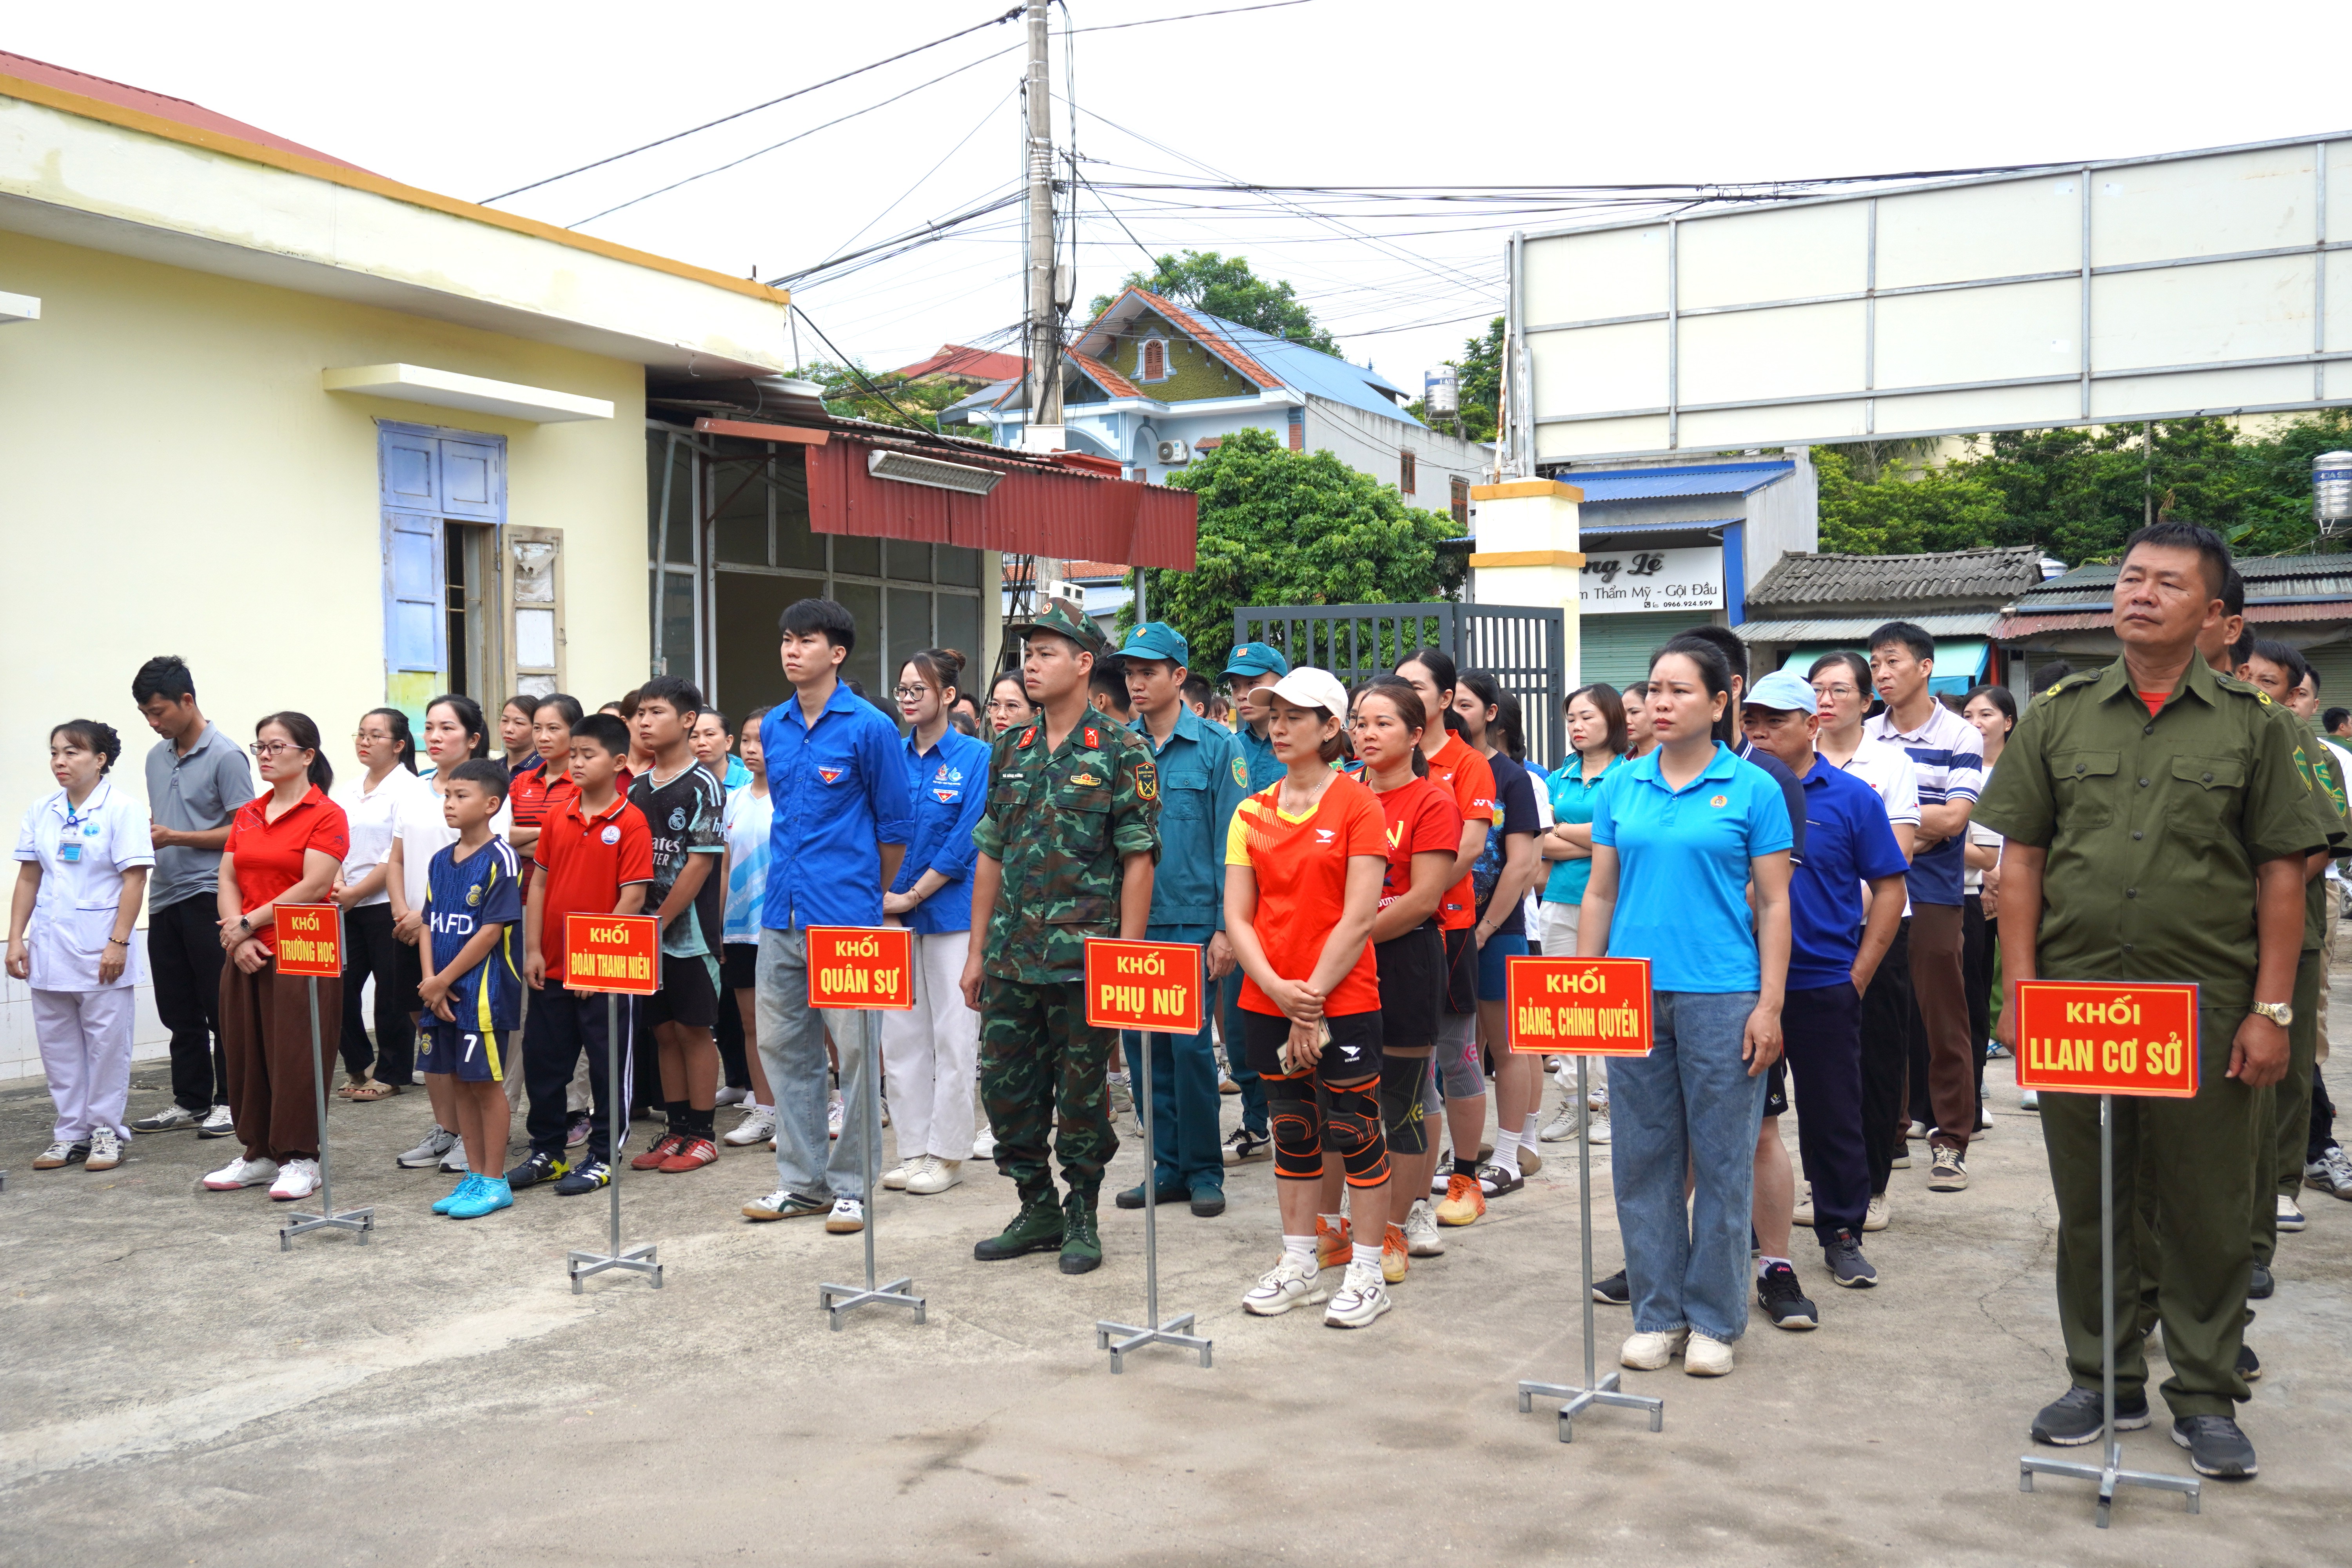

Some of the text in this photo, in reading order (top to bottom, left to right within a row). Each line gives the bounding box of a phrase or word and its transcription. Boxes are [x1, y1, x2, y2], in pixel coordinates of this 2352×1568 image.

[1580, 553, 1664, 583] ng Lê
[1594, 585, 1626, 599] Thẩm
[1632, 586, 1651, 601] Mỹ
[1666, 584, 1686, 598] Gội
[1692, 582, 1717, 595] Đầu
[652, 837, 680, 853] ates
[292, 911, 319, 931] KHỐI
[590, 923, 629, 944] KHỐI
[280, 935, 335, 967] TRƯỜNG HỌC
[835, 935, 879, 957] KHỐI
[572, 948, 650, 980] ĐOÀN THANH NIÊN
[1117, 951, 1165, 976] KHỐI
[820, 964, 900, 1000] QUÂN SỰ
[1546, 967, 1606, 993] KHỐI
[1101, 984, 1187, 1019] PHỤ NỮ
[2066, 995, 2140, 1025] KHỐI
[1519, 997, 1639, 1040] ĐẢNG, CHÍNH QUYỀN
[464, 1034, 477, 1062] 7
[2030, 1031, 2182, 1076] LLAN CƠ SỞ
